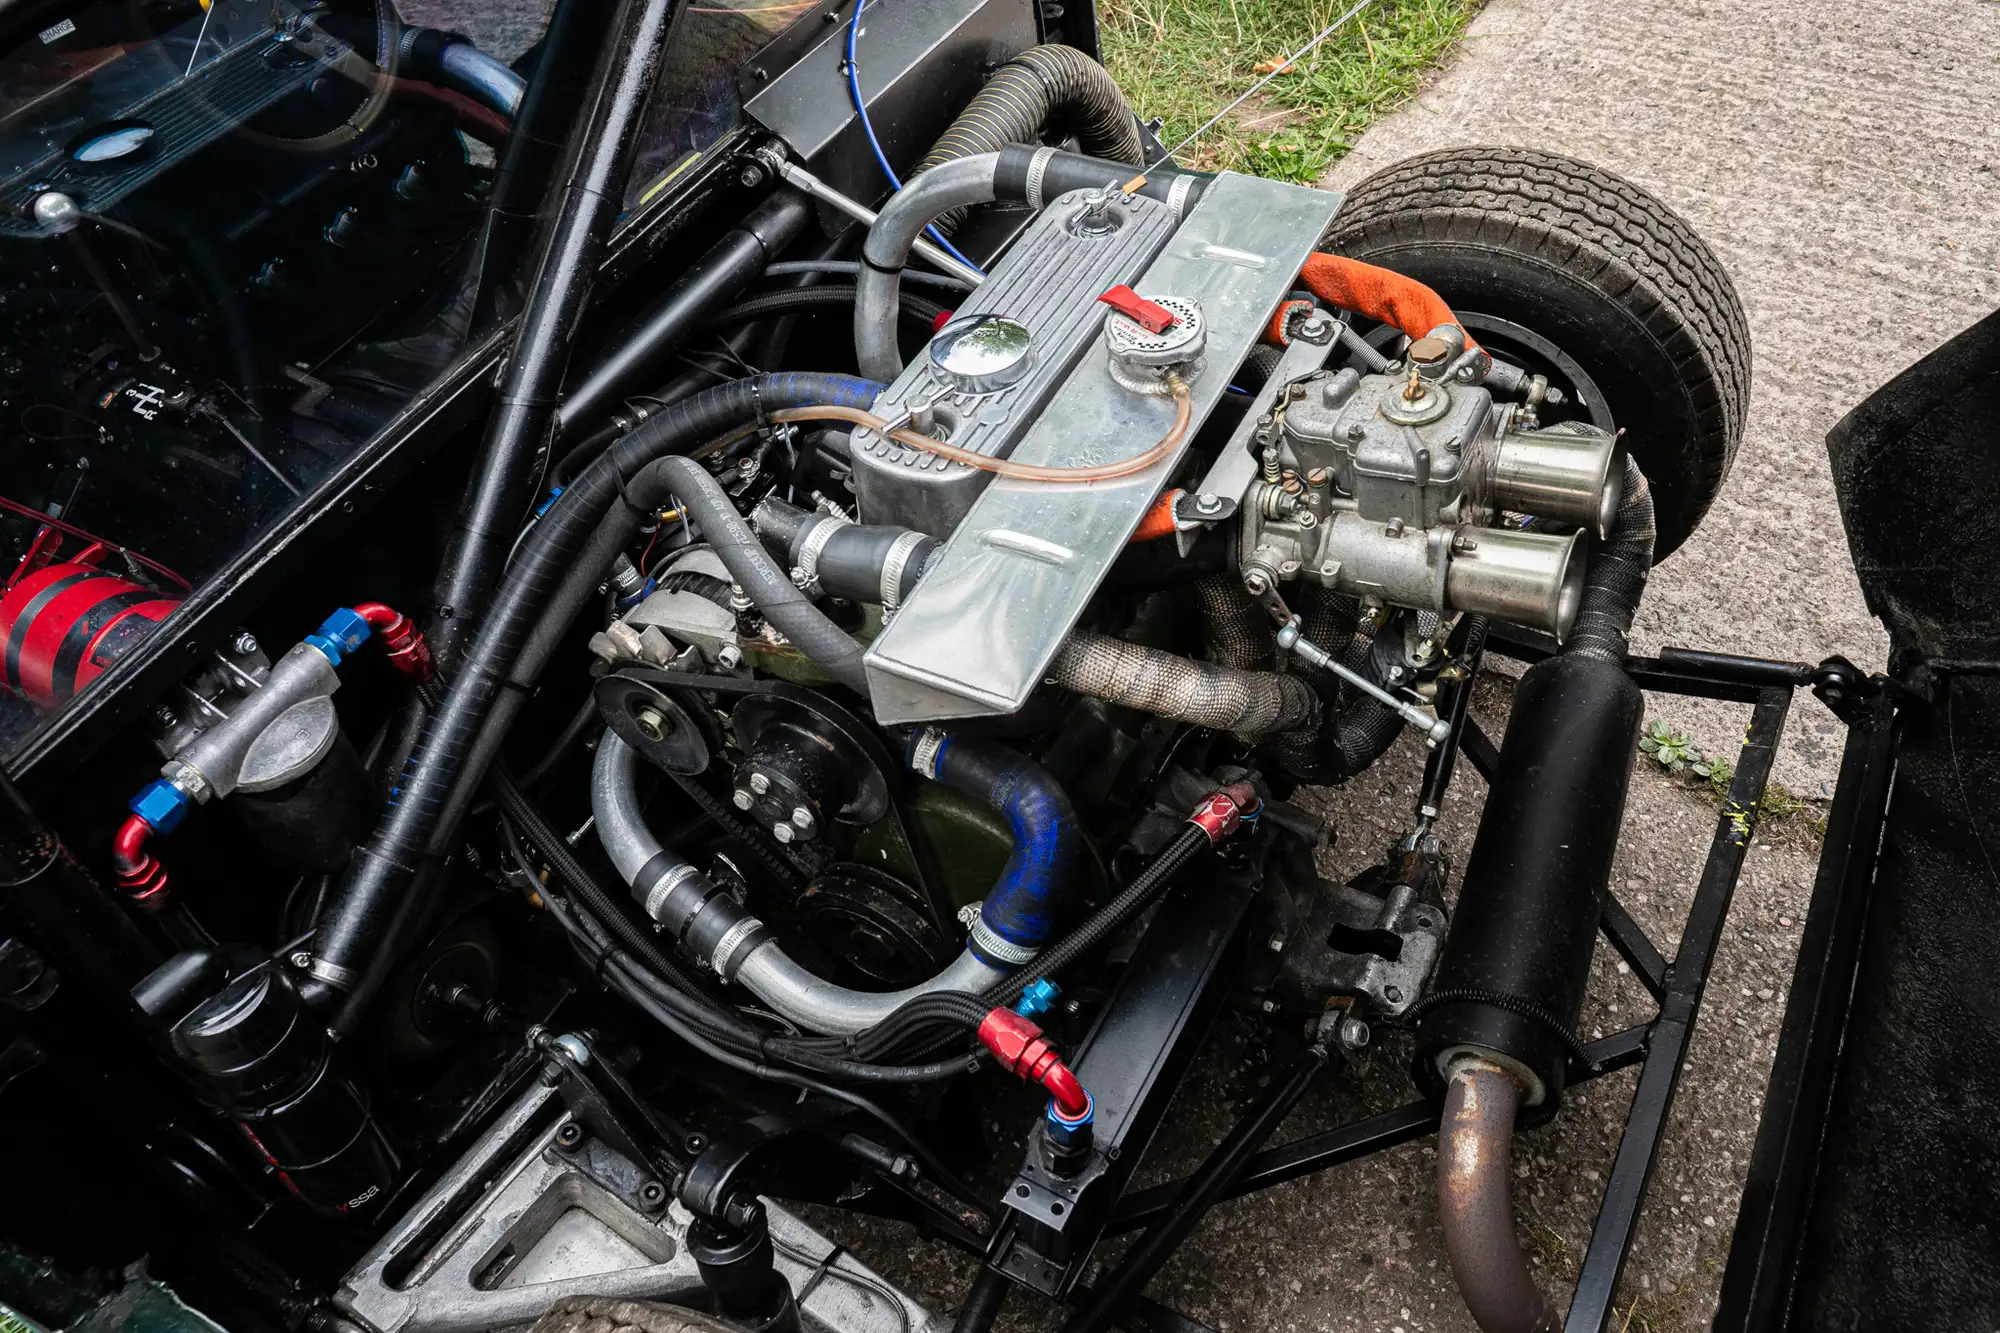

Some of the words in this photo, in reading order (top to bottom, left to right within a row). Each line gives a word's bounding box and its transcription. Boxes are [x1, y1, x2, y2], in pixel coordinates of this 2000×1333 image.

[40, 19, 74, 41] CHARGE
[143, 409, 158, 420] R
[743, 548, 780, 585] AEROQUIP
